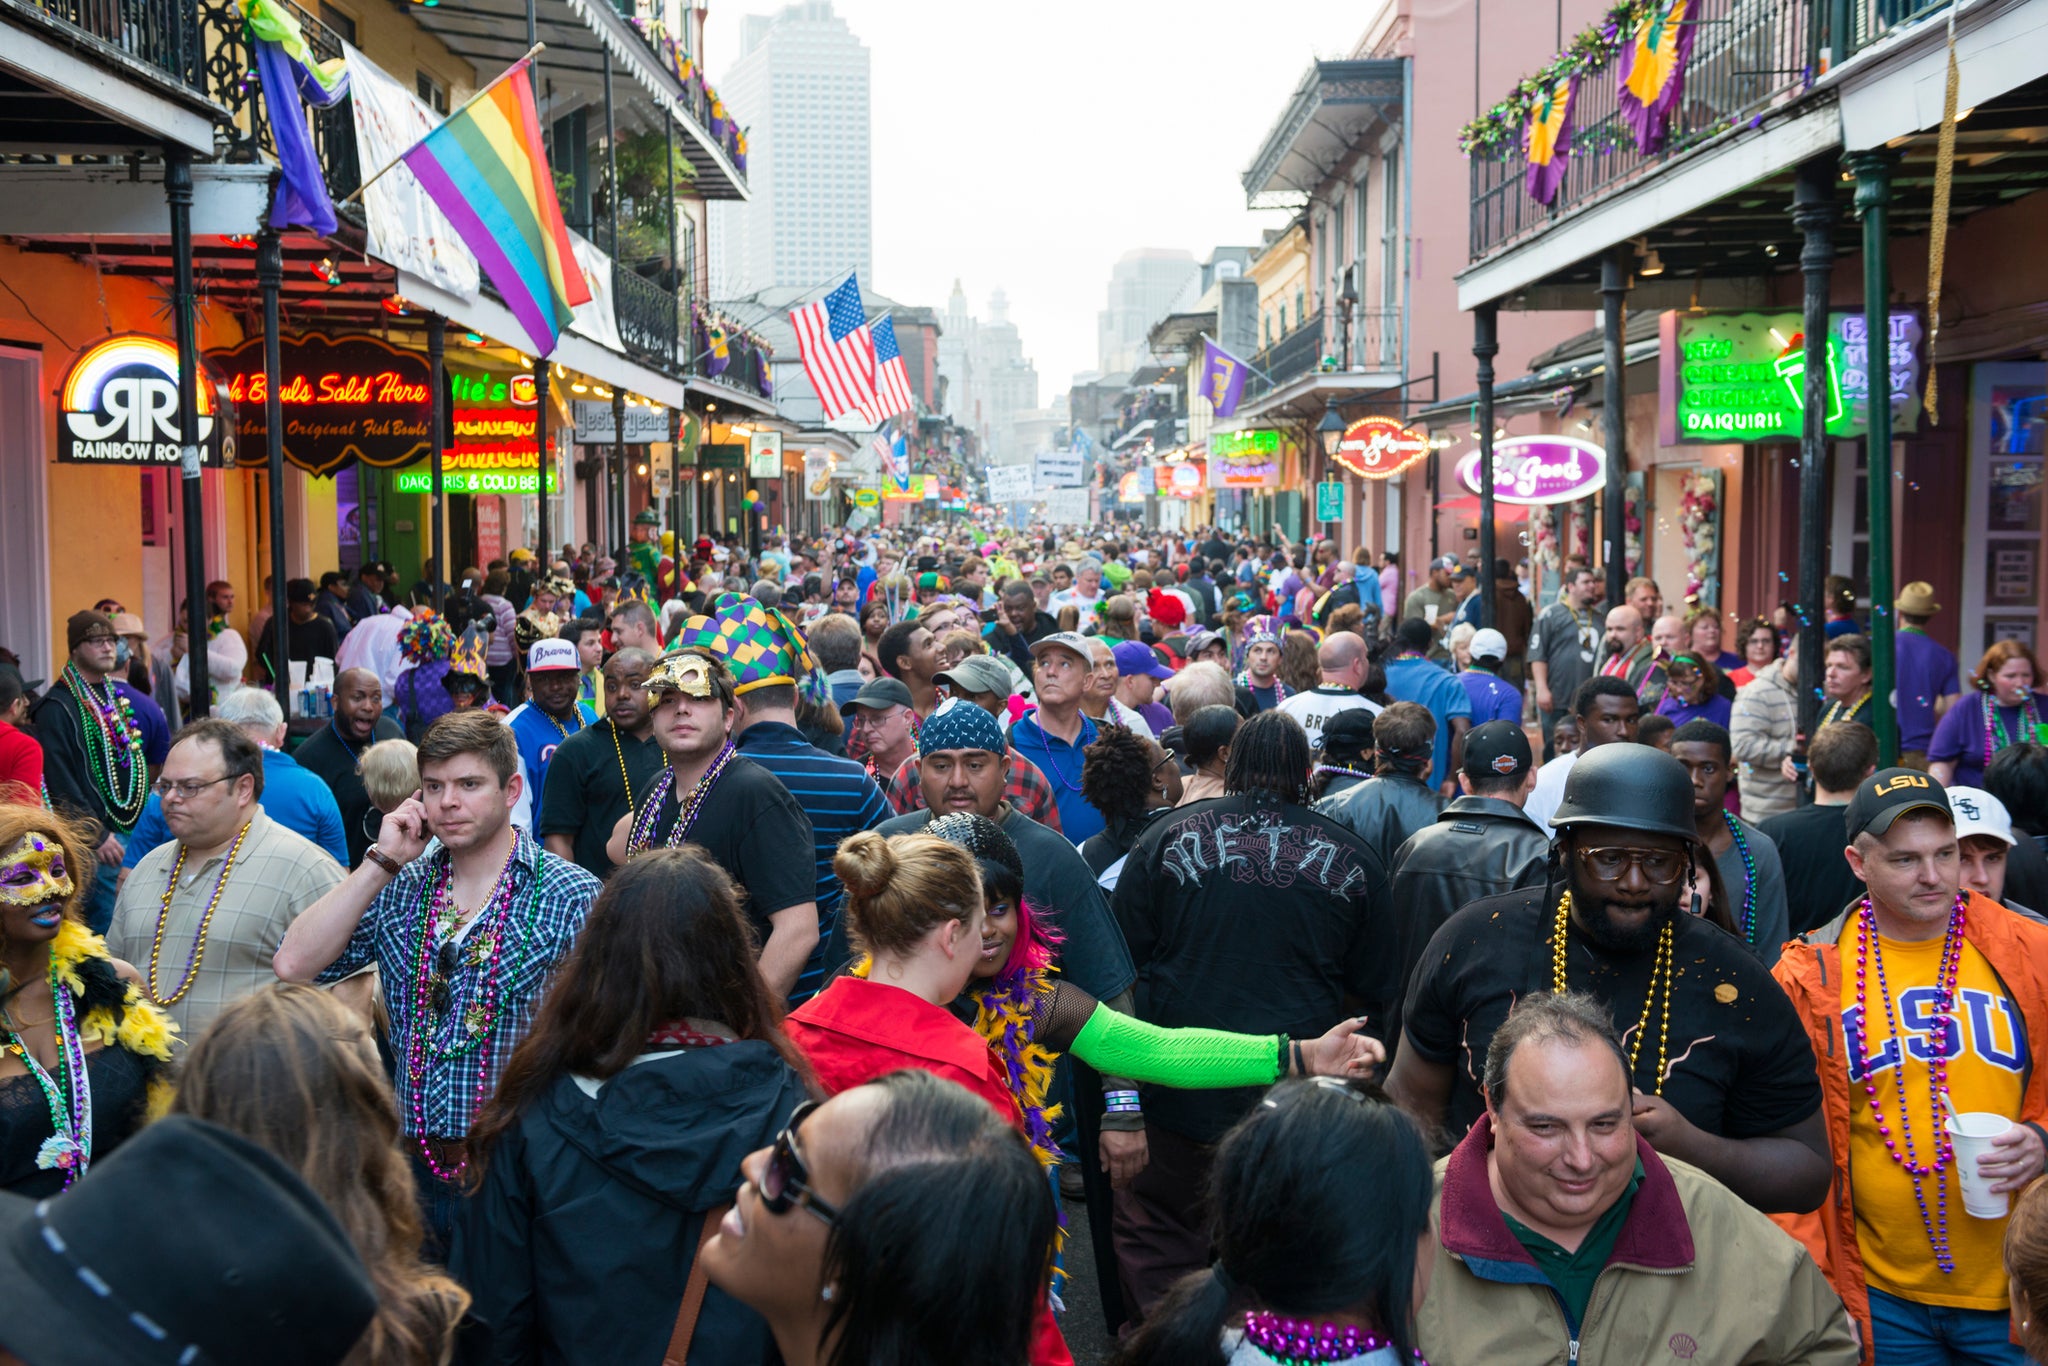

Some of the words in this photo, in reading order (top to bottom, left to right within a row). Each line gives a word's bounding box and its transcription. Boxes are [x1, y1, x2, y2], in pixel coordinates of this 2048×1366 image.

[1685, 339, 1733, 361] NEW
[316, 371, 370, 403] Sold
[376, 370, 427, 402] Here
[1685, 387, 1782, 408] ORIGINAL
[287, 419, 356, 440] Original
[363, 418, 389, 437] Fish
[1687, 411, 1783, 431] DAIQUIRIS
[72, 441, 152, 461] RAINBOW
[399, 475, 465, 489] DAIQRIS
[467, 474, 480, 490] &
[482, 474, 517, 490] COLD
[535, 646, 572, 663] Braves
[1874, 775, 1930, 797] LSU
[1841, 985, 2027, 1084] LSU
